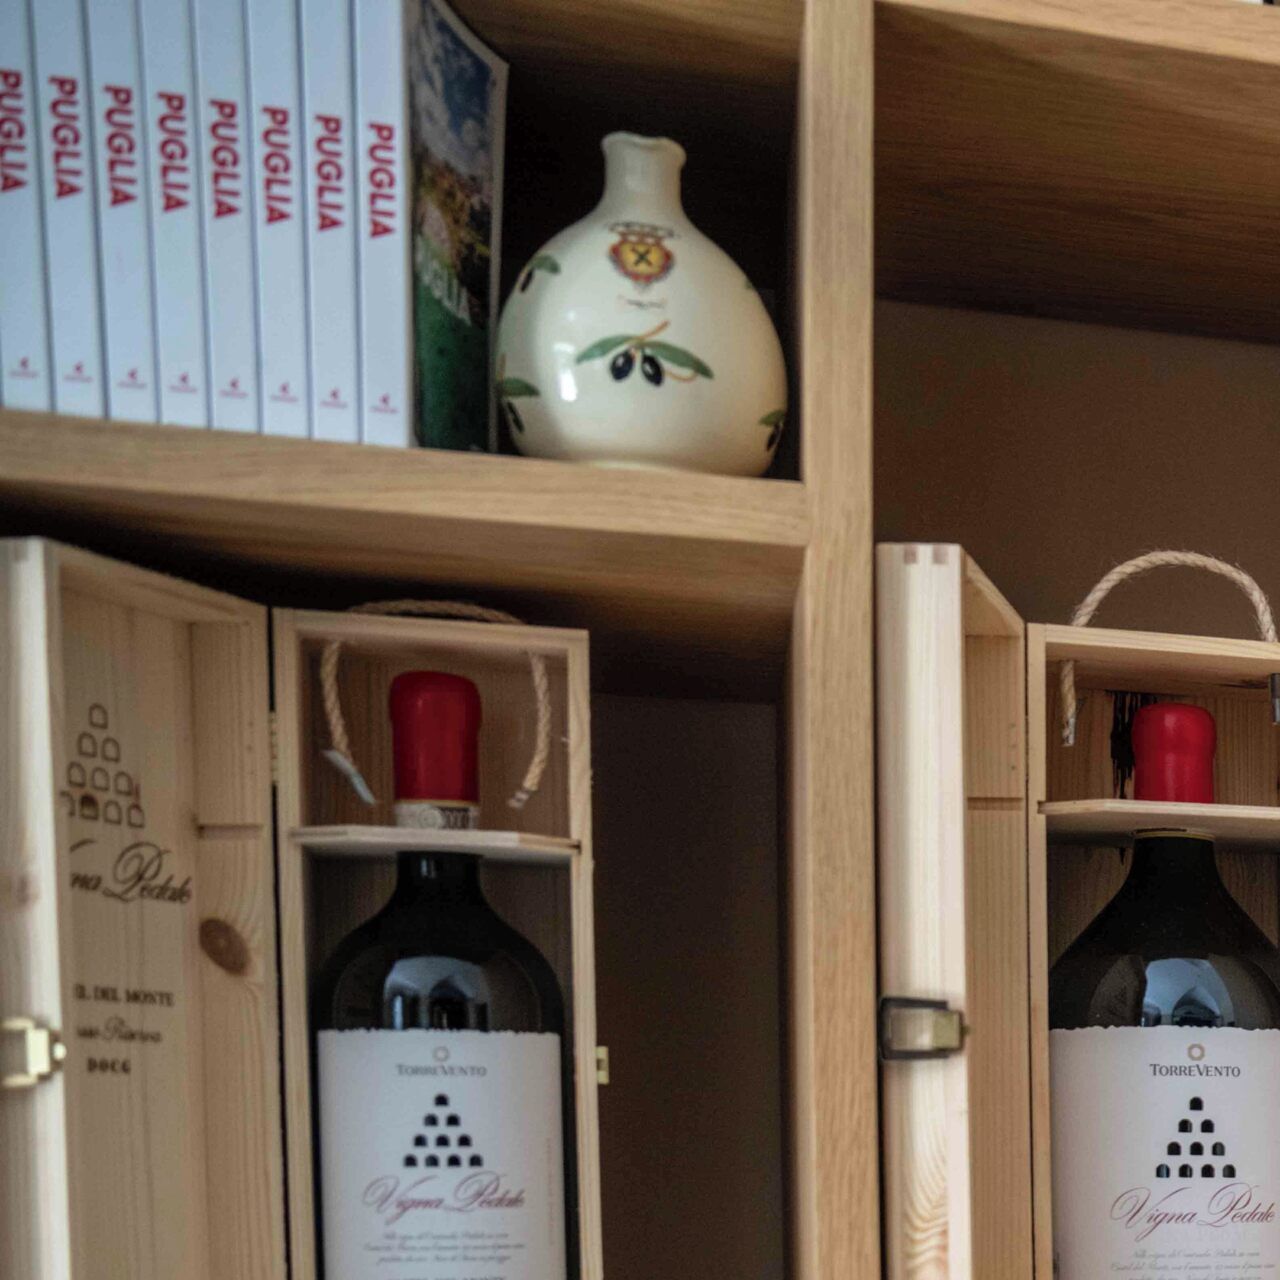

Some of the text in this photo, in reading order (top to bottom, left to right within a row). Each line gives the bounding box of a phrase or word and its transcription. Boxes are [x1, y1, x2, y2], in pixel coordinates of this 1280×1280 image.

[48, 75, 82, 200] PUGLIA
[104, 84, 137, 207] PUGLIA
[157, 91, 190, 212] PUGLIA
[209, 99, 240, 219] PUGLIA
[261, 106, 292, 225] PUGLIA
[314, 114, 344, 231] PUGLIA
[367, 121, 396, 238] PUGLIA
[1110, 1183, 1276, 1241] Vigna Pedale
